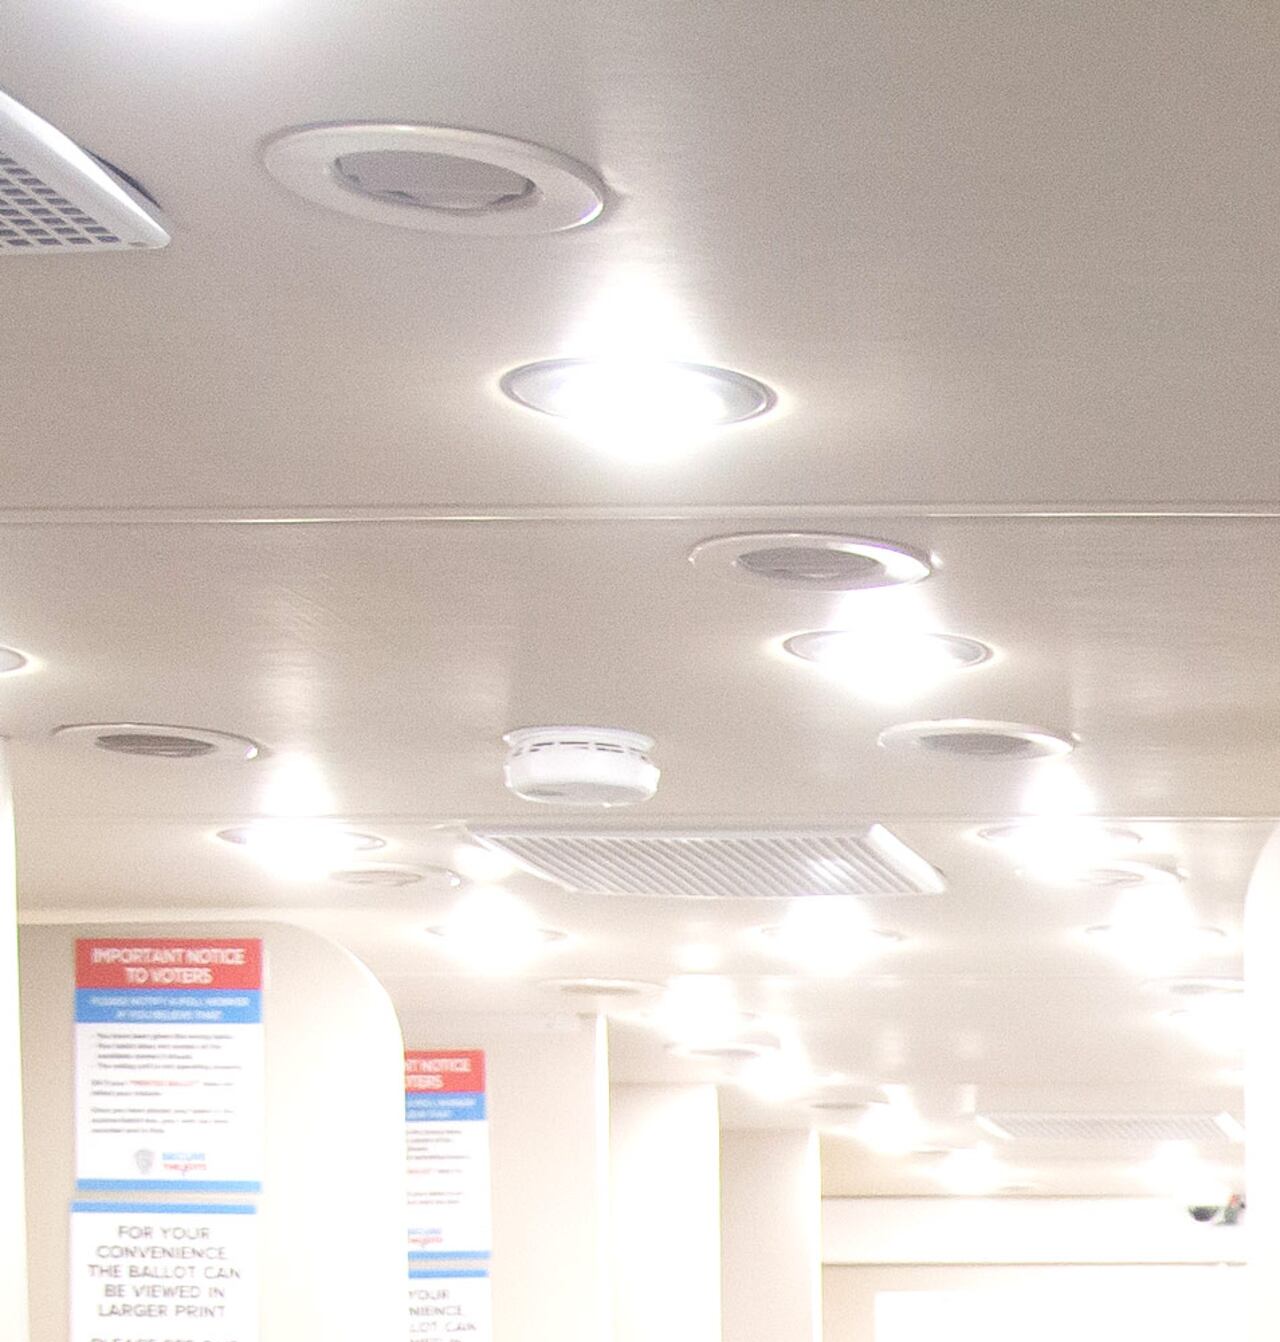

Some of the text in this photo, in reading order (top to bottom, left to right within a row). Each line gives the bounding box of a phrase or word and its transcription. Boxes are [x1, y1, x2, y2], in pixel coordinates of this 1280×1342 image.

[91, 947, 246, 966] IMPORTANT NOTICE
[125, 967, 214, 985] TO VOTERS
[118, 1225, 210, 1241] FOR YOUR
[95, 1244, 228, 1261] CONVENIENCE
[88, 1263, 241, 1281] THE BALLOT CAN
[104, 1283, 226, 1299] BE VIEWED IN
[97, 1303, 227, 1319] LARGER PRINT
